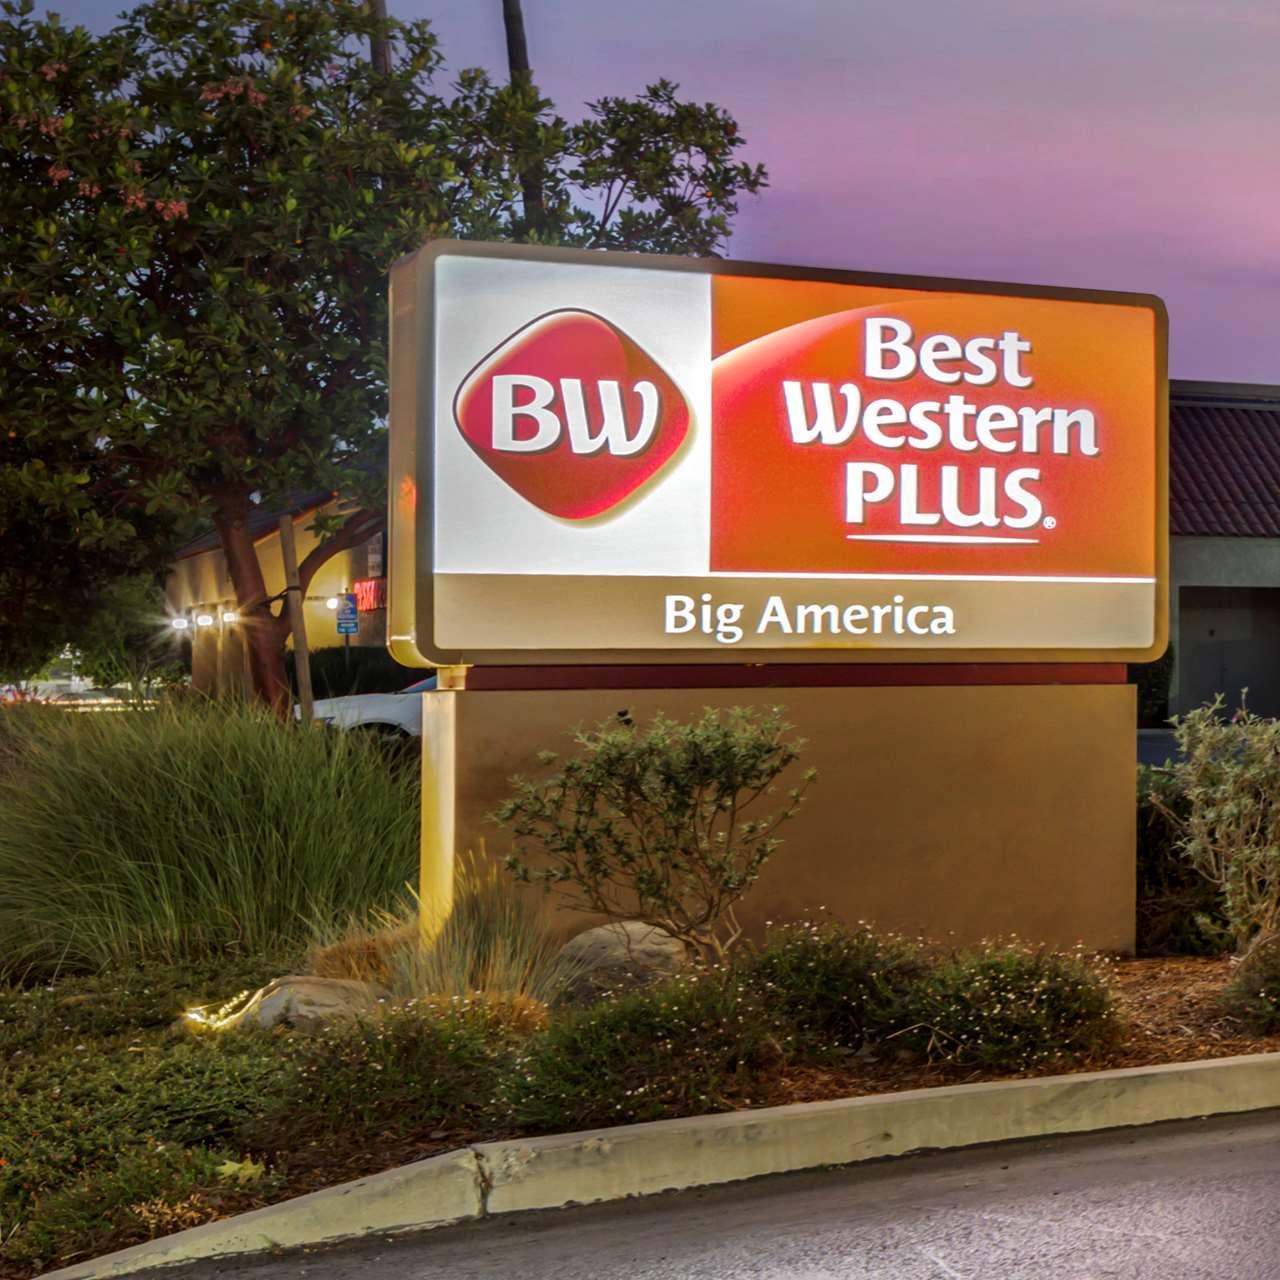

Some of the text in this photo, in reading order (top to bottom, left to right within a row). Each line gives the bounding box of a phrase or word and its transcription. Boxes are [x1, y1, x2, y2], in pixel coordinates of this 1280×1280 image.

[864, 316, 1034, 388] Best
[491, 374, 660, 456] BW
[782, 380, 1100, 456] Western
[664, 593, 957, 644] Big America
